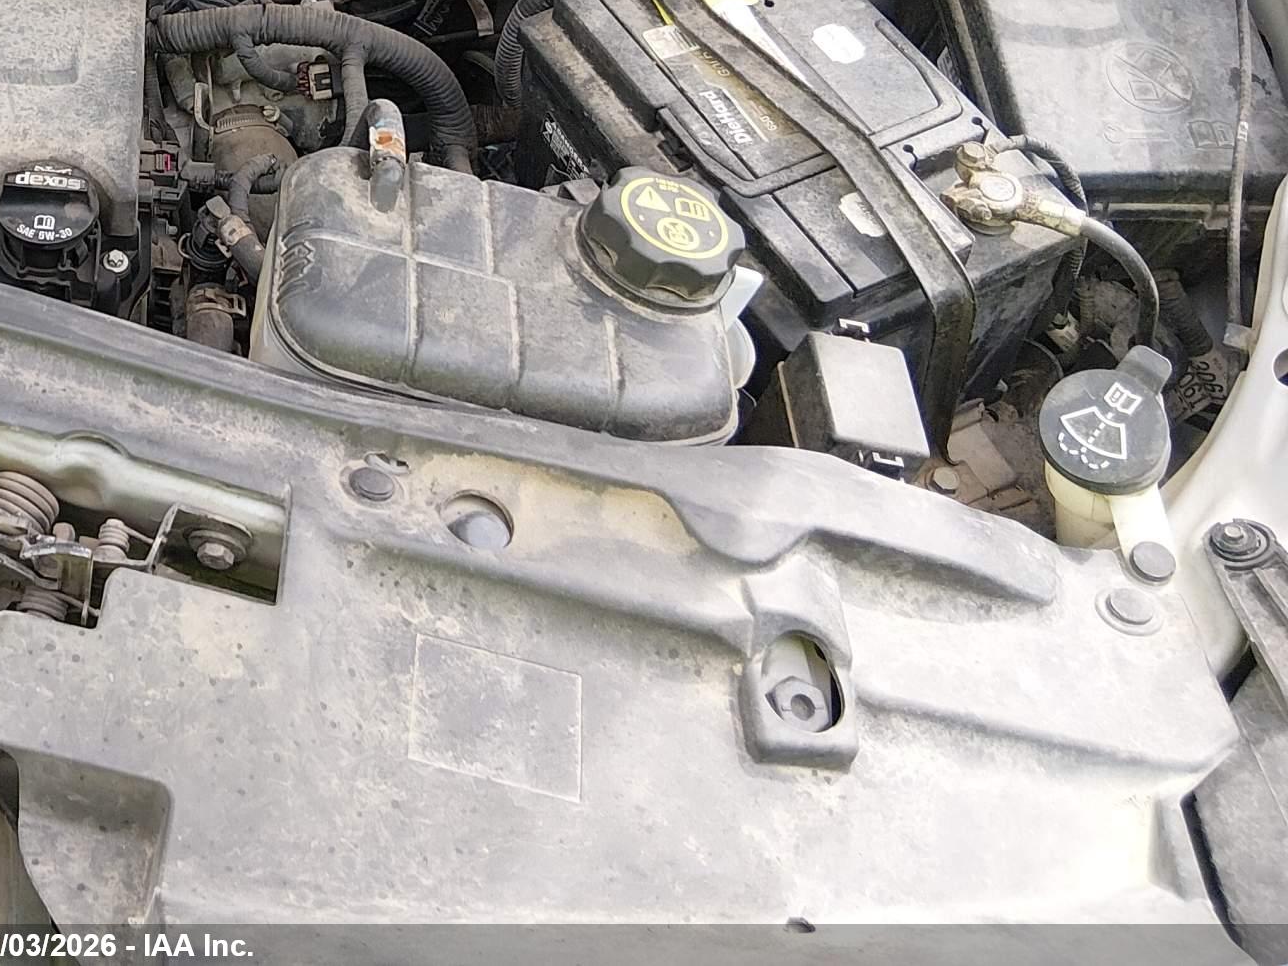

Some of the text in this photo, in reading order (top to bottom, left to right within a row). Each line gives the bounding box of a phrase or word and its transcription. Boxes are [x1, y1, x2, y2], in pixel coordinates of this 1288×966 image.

[699, 89, 753, 145] DieHard
[15, 171, 82, 190] dexos
[16, 224, 73, 241] SAE 5W-30
